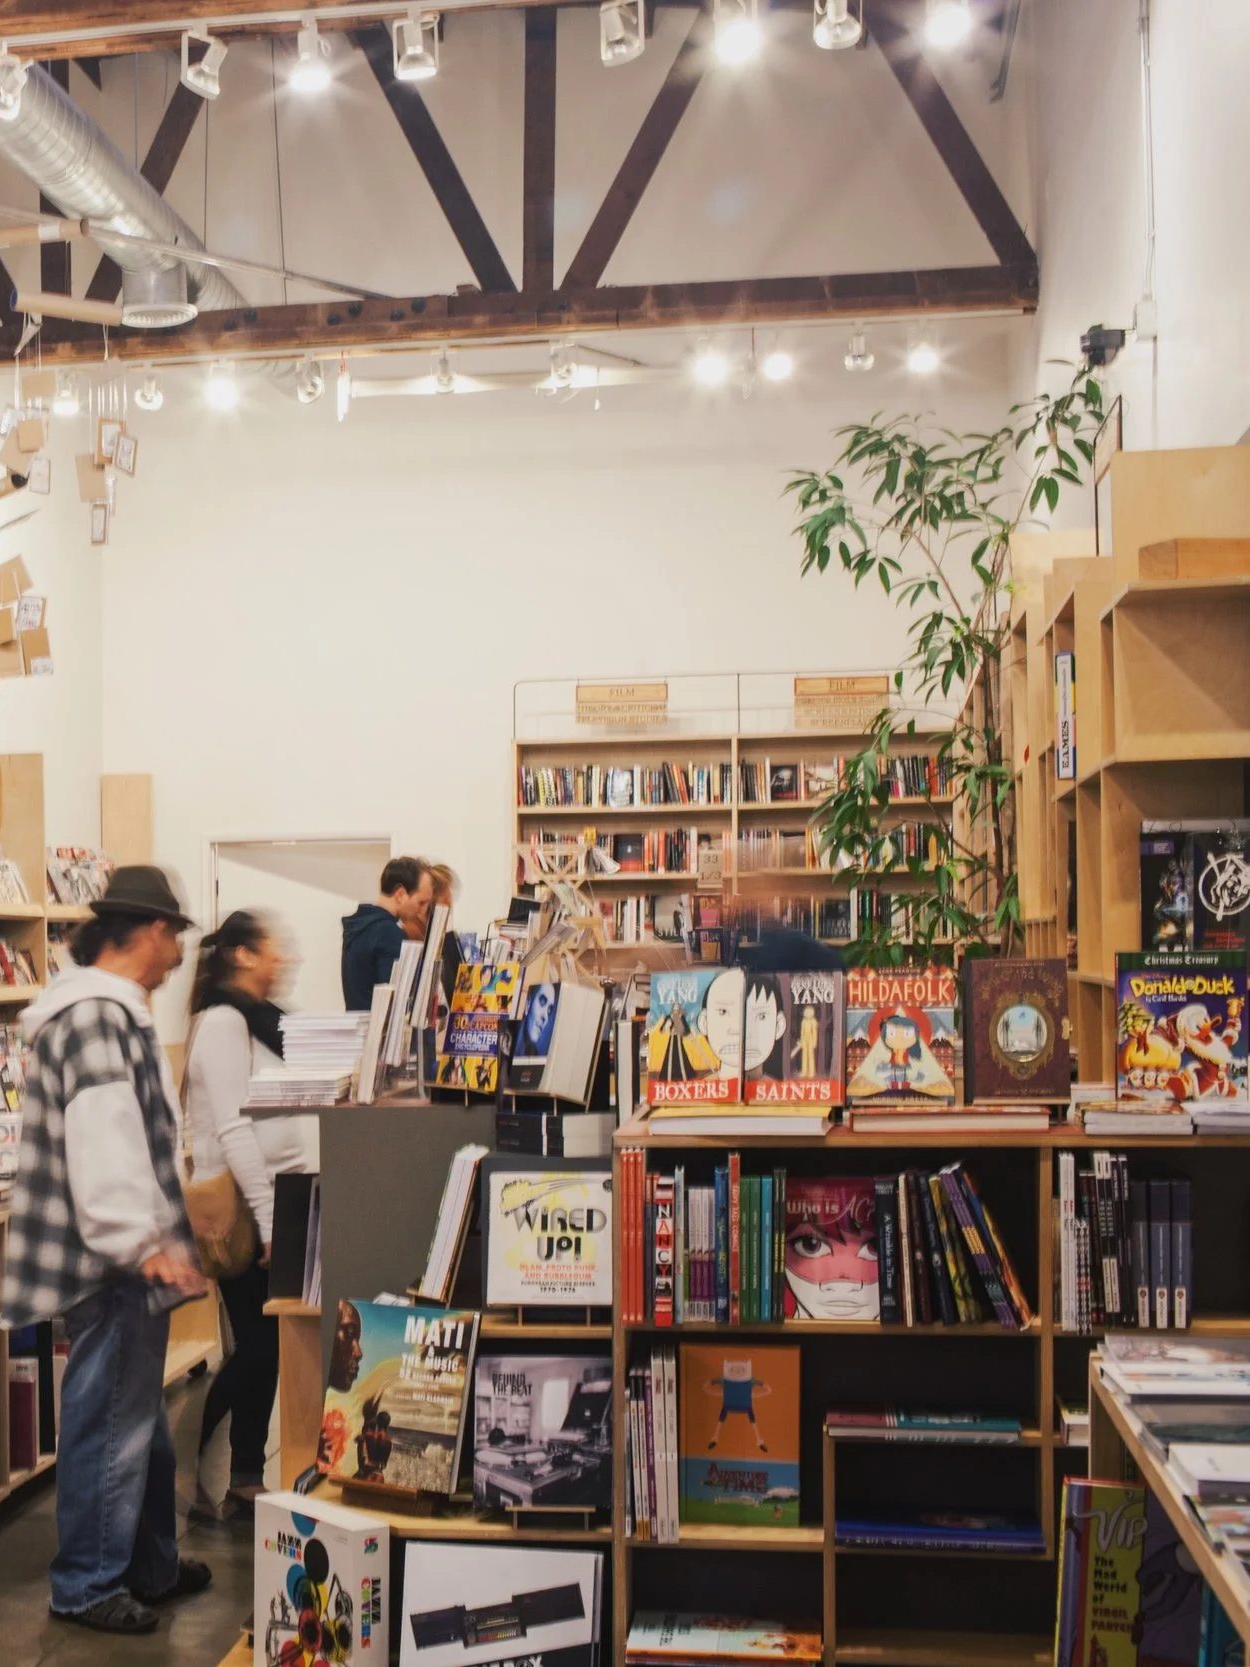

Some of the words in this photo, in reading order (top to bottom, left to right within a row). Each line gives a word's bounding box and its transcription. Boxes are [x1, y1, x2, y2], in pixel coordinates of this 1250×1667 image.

[609, 687, 635, 697] FILM
[829, 680, 856, 690] FILM
[1061, 719, 1070, 770] EAMES
[1144, 954, 1184, 966] Christmas
[1185, 953, 1220, 966] Treasury
[848, 977, 951, 1003] HILDAFOLK
[1130, 974, 1187, 998] Donald
[1192, 973, 1236, 996] Duck
[658, 987, 699, 1005] YANG
[792, 987, 835, 1005] YANG
[449, 1030, 499, 1045] CHARACTER
[654, 1080, 729, 1102] BOXERS
[755, 1080, 832, 1101] SAINTS
[513, 1205, 608, 1233] WIRED
[786, 1200, 821, 1220] Who
[824, 1200, 840, 1214] is
[536, 1235, 582, 1262] UP!
[656, 1202, 673, 1277] NANCY
[403, 1314, 466, 1350] MATI
[401, 1352, 422, 1369] THE
[425, 1355, 460, 1373] MUSIC
[491, 1372, 527, 1386] BEHIND
[492, 1382, 508, 1397] THE
[1074, 1498, 1149, 1553] VIP
[1093, 1555, 1115, 1568] The
[1093, 1568, 1118, 1581] Mad
[1093, 1581, 1128, 1594] World
